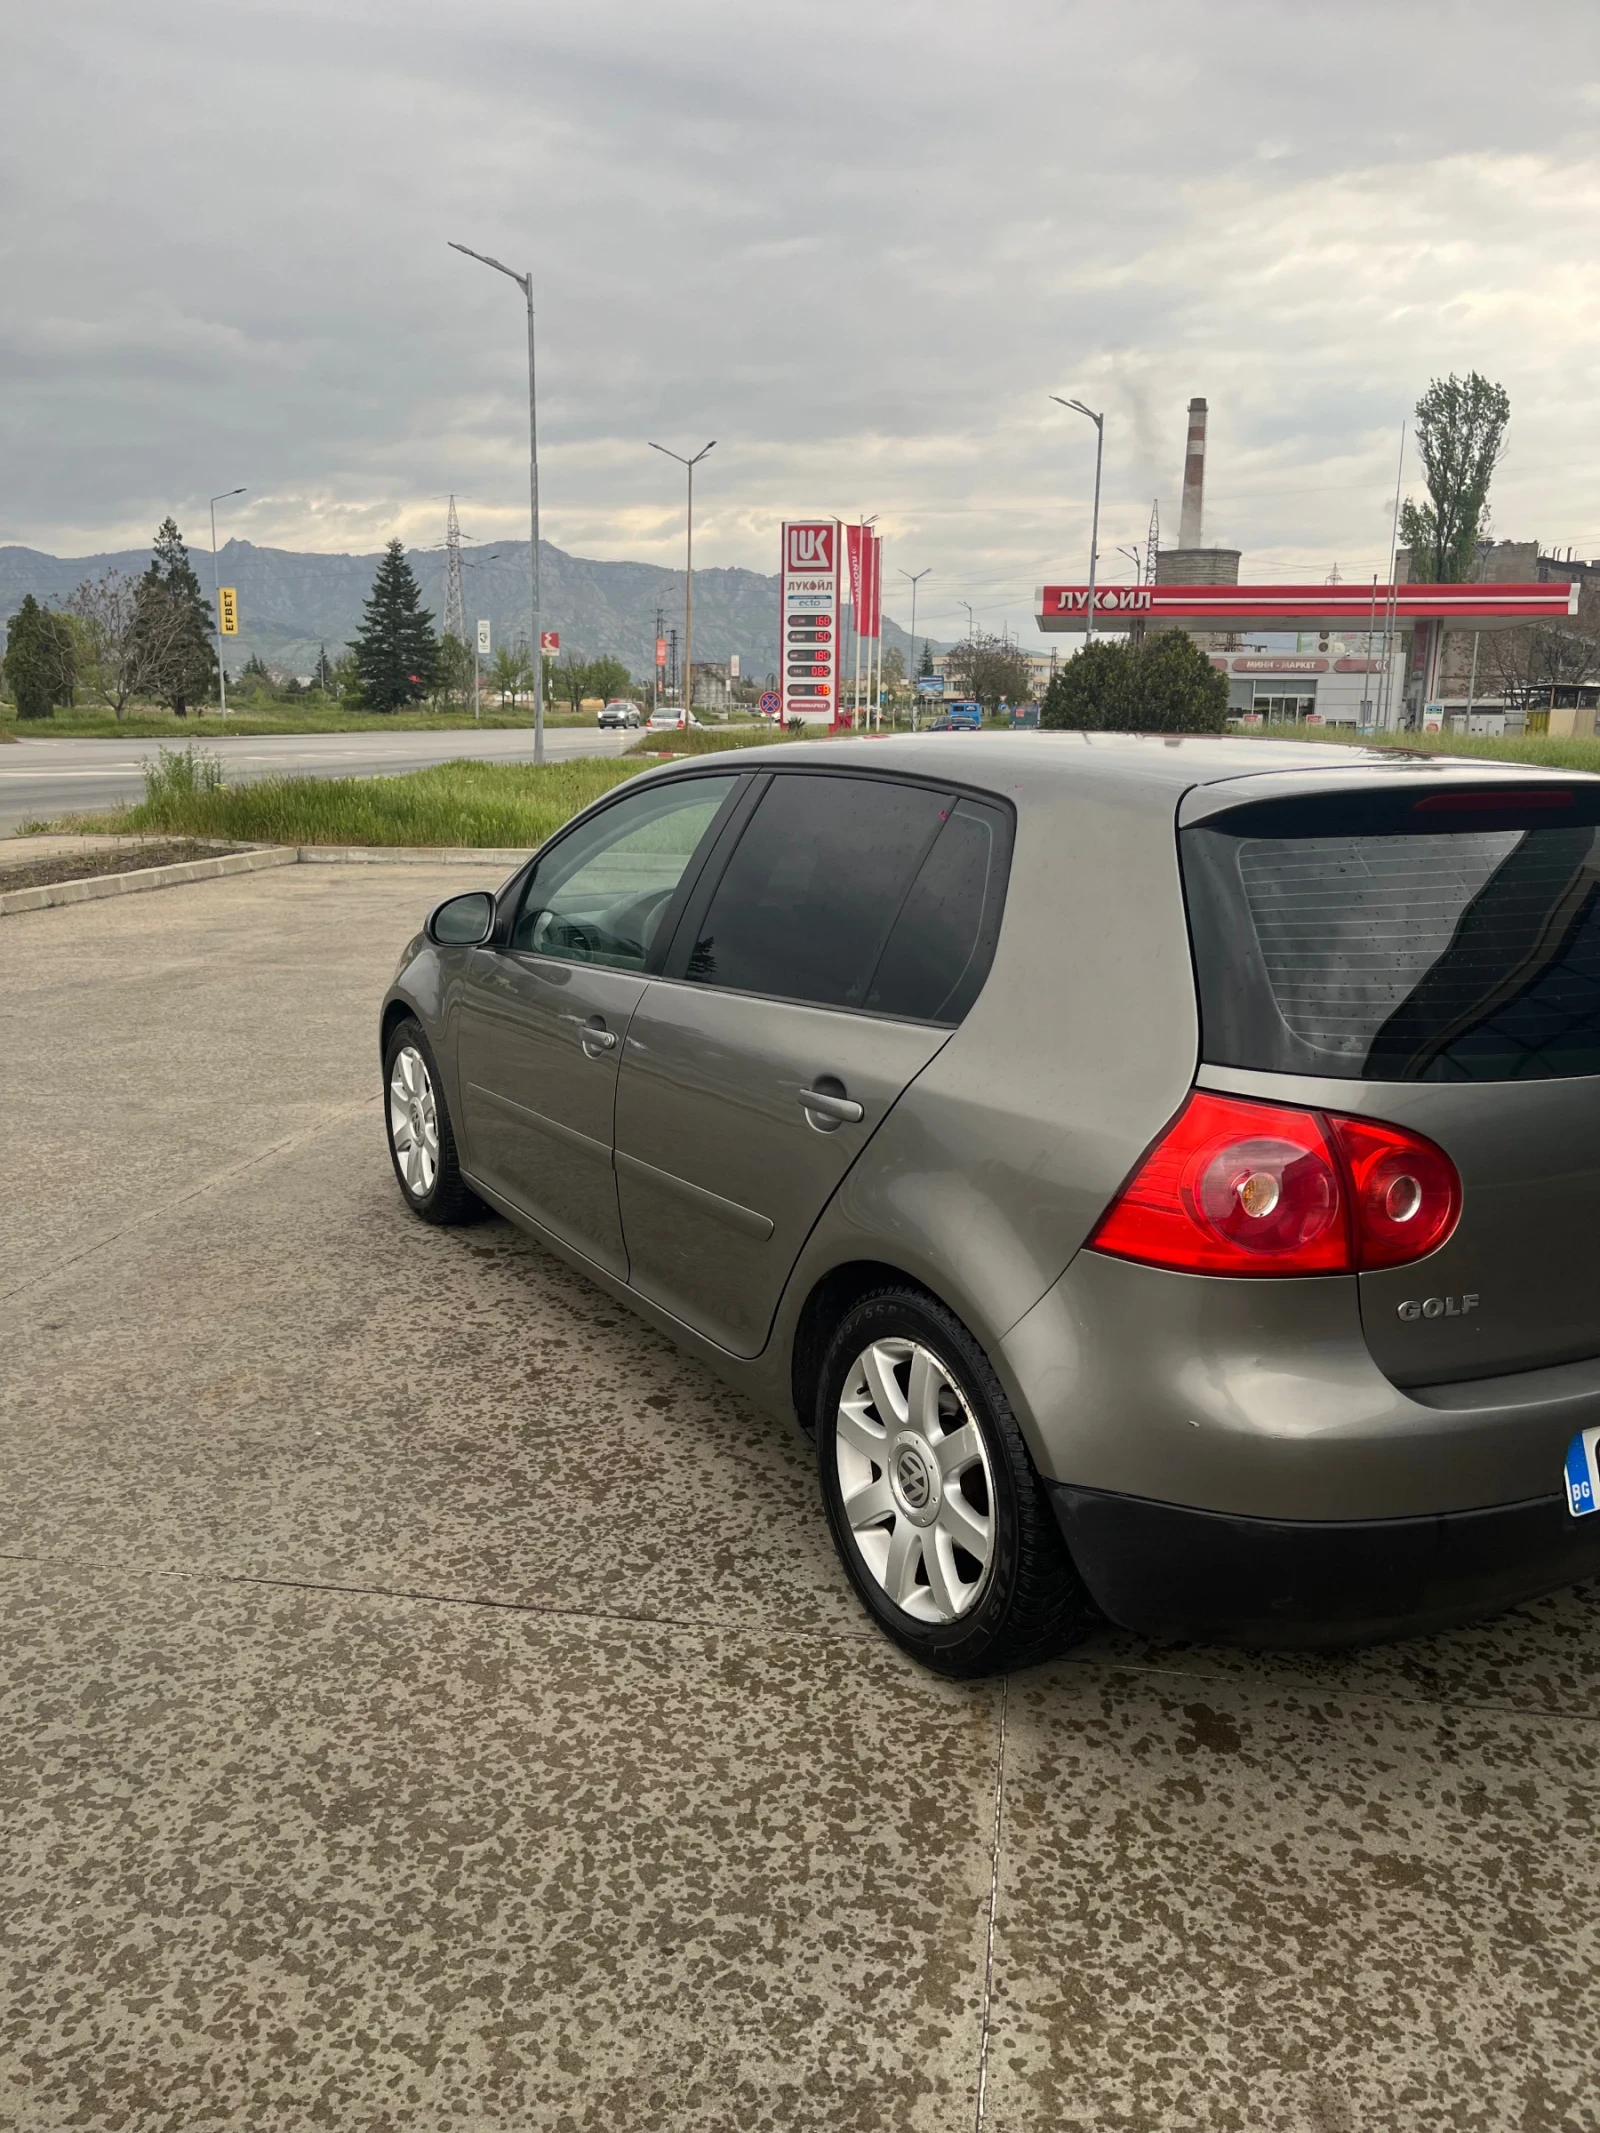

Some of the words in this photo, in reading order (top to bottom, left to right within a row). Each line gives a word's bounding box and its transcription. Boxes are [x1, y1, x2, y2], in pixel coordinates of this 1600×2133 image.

[224, 591, 234, 631] EFBET
[1246, 661, 1274, 669] МИНИ
[1281, 661, 1316, 669] МАРКЕТ
[1397, 1294, 1480, 1321] GOLF
[1571, 1481, 1591, 1502] BG
